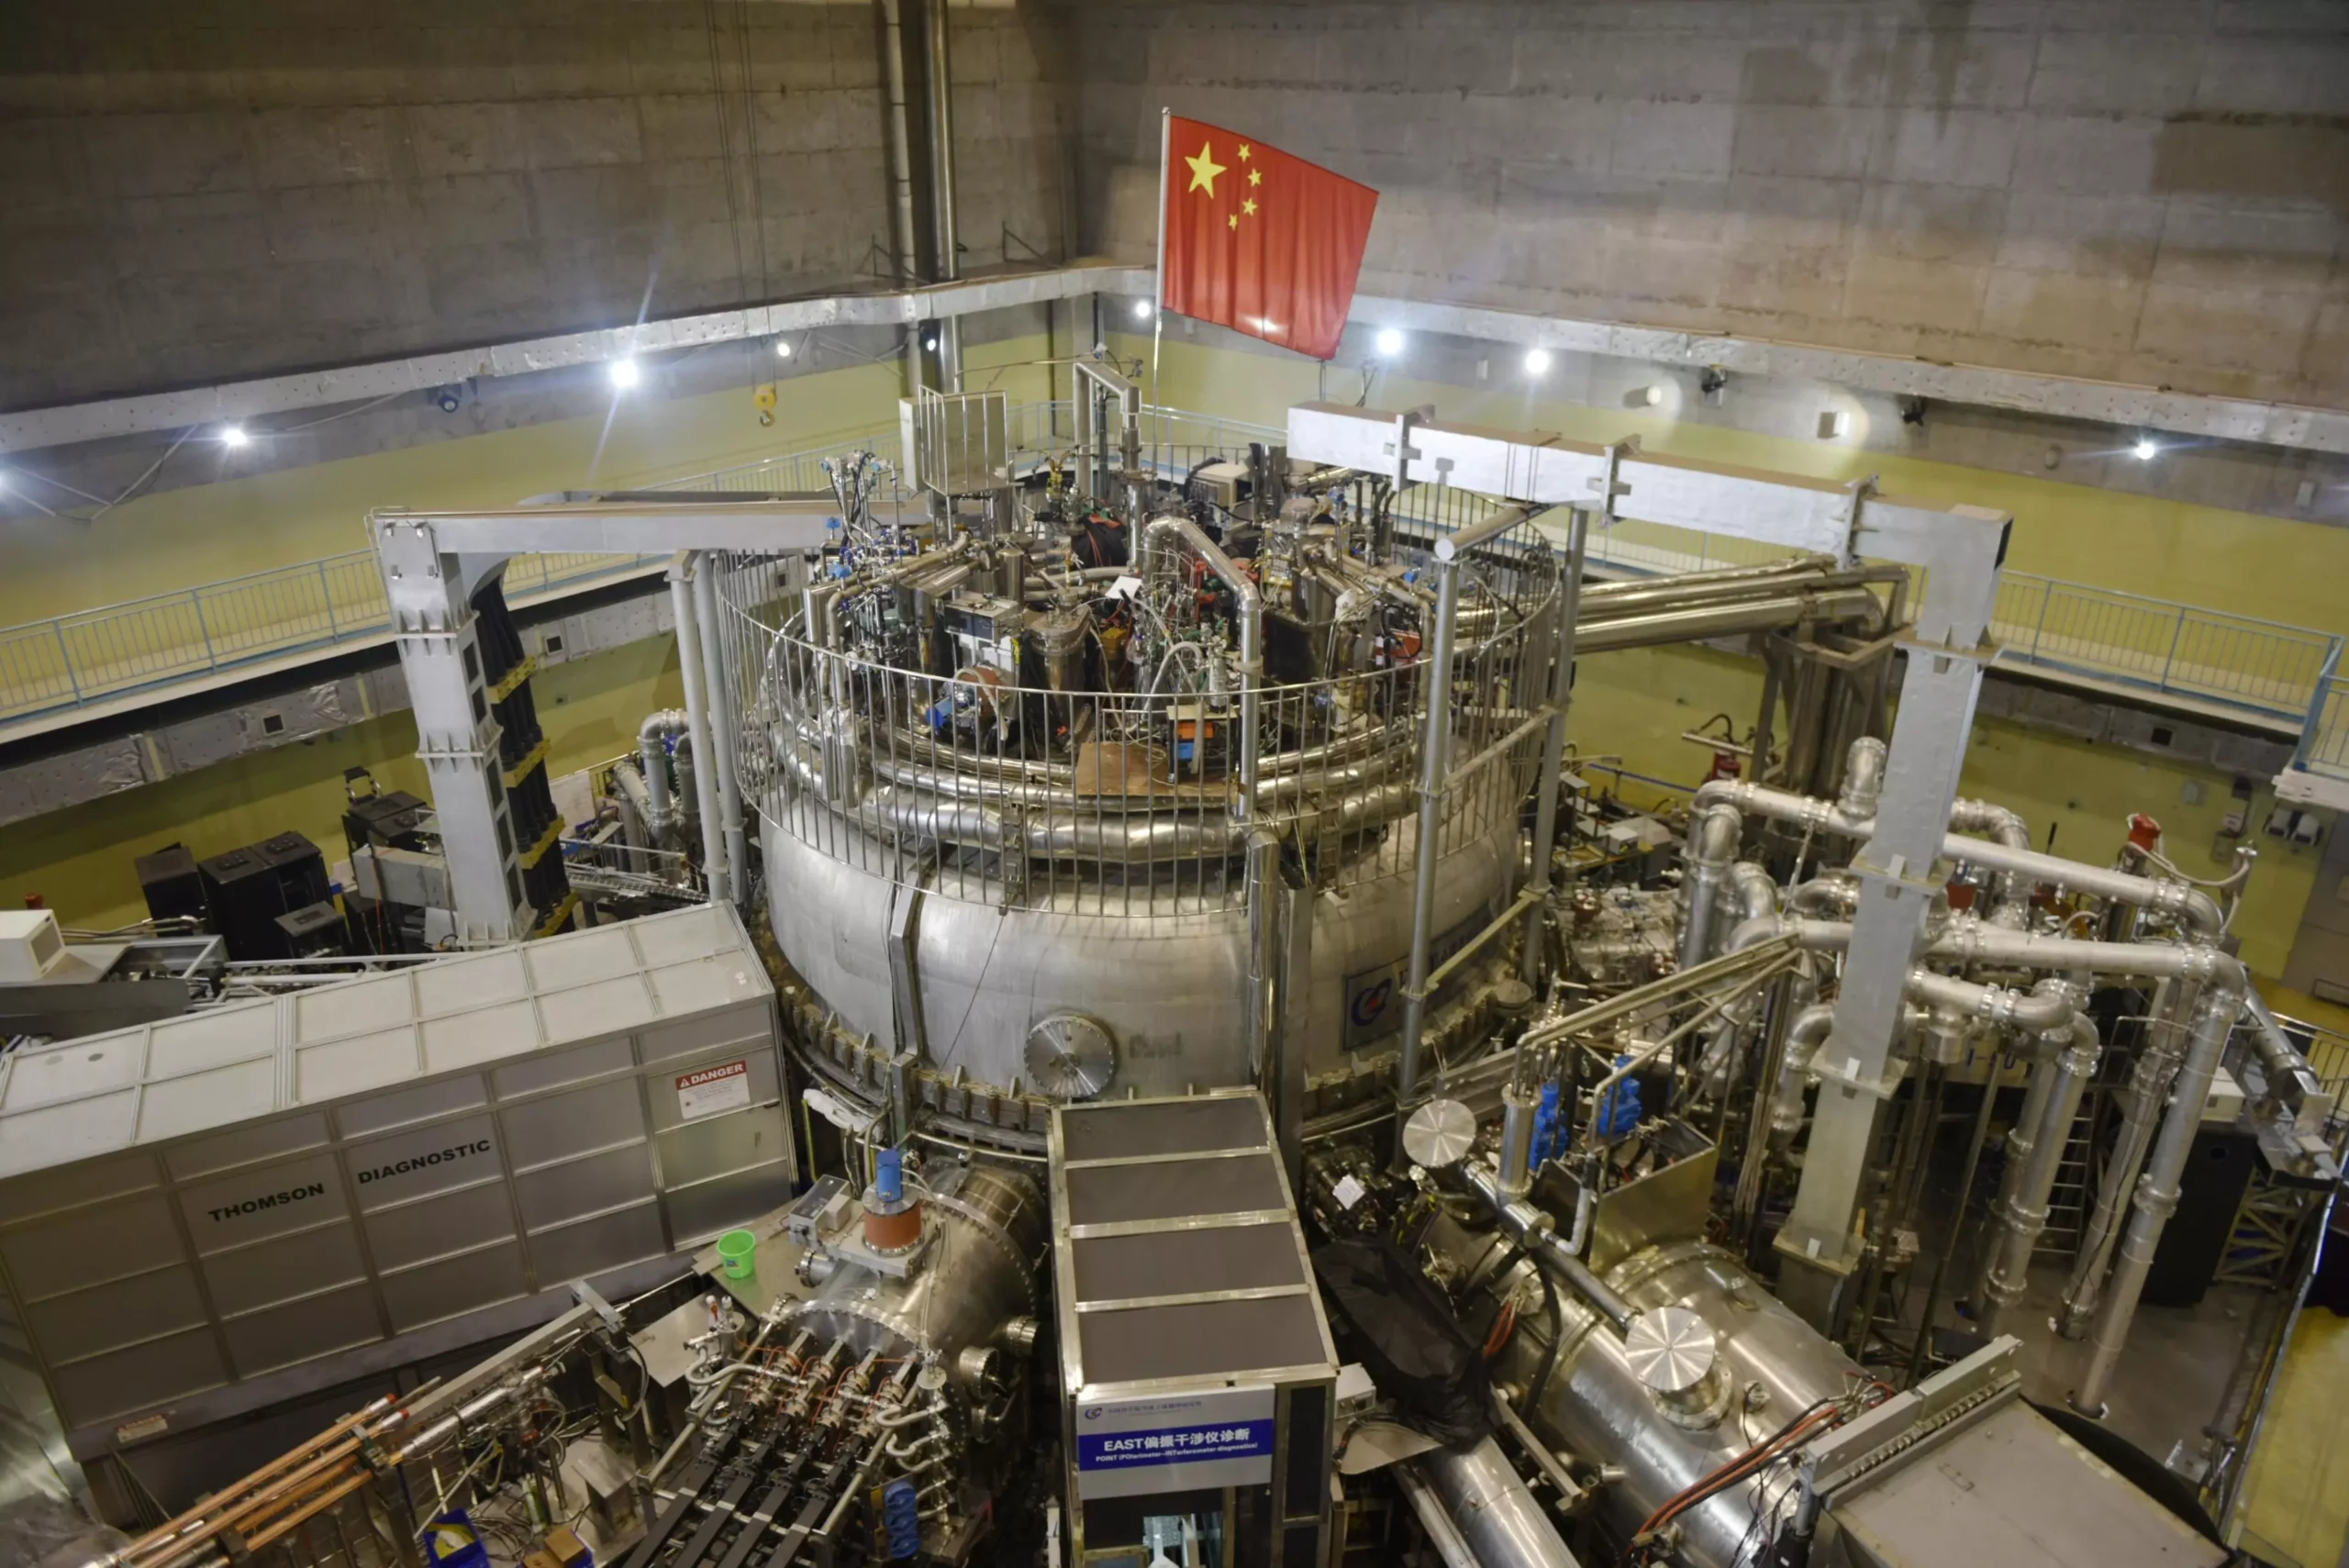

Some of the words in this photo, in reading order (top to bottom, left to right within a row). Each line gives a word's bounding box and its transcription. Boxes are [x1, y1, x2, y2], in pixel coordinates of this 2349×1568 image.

[691, 1063, 744, 1084] DANGER
[208, 1183, 325, 1222] THOMSON
[358, 1140, 491, 1184] DIAGNOSTIC
